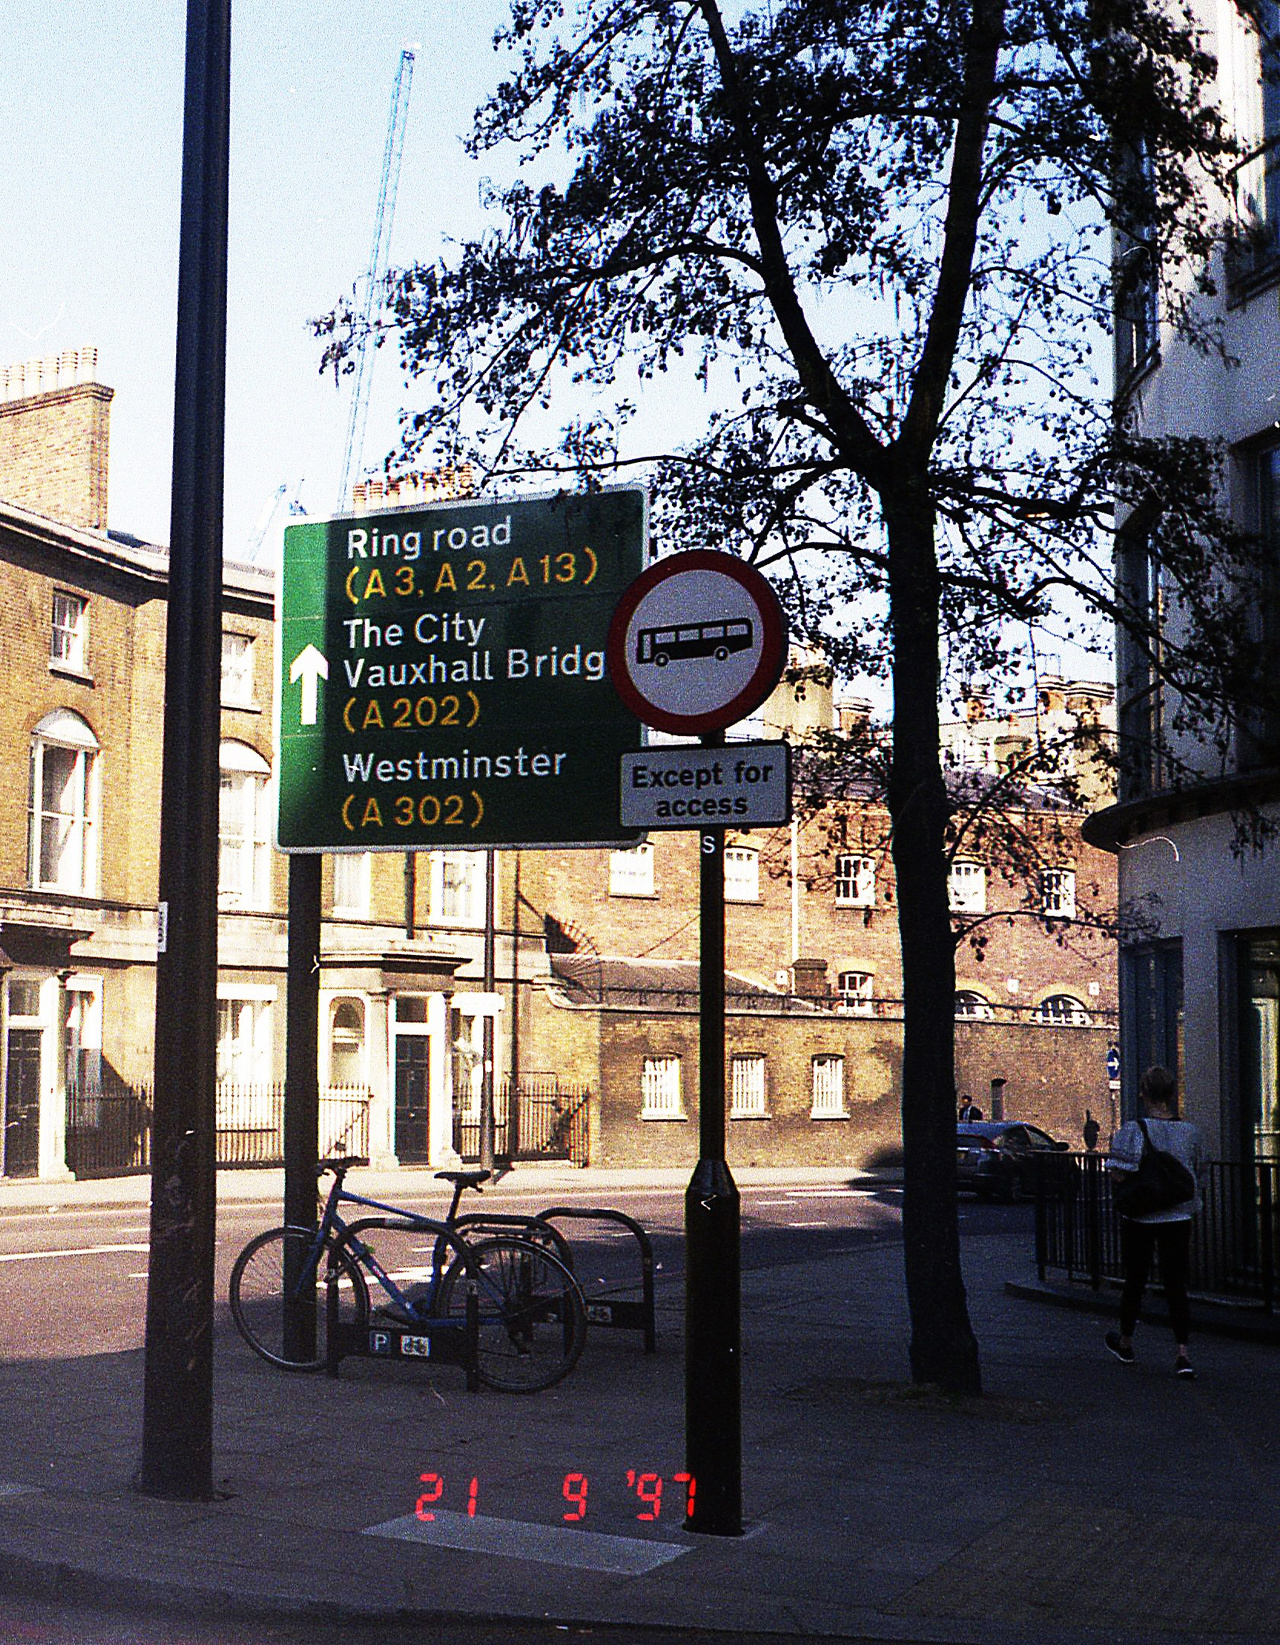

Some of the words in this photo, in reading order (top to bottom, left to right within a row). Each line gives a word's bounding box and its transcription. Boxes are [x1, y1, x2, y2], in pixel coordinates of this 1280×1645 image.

[347, 527, 421, 560] Ring
[433, 515, 512, 551] road
[343, 618, 404, 649] The
[414, 612, 486, 647] City
[343, 650, 494, 688] Vauxhall
[507, 643, 606, 681] Bridg
[342, 747, 567, 783] Westminster
[632, 762, 723, 789] Except
[734, 761, 774, 784] for
[656, 797, 749, 818] access
[375, 1333, 388, 1351] P
